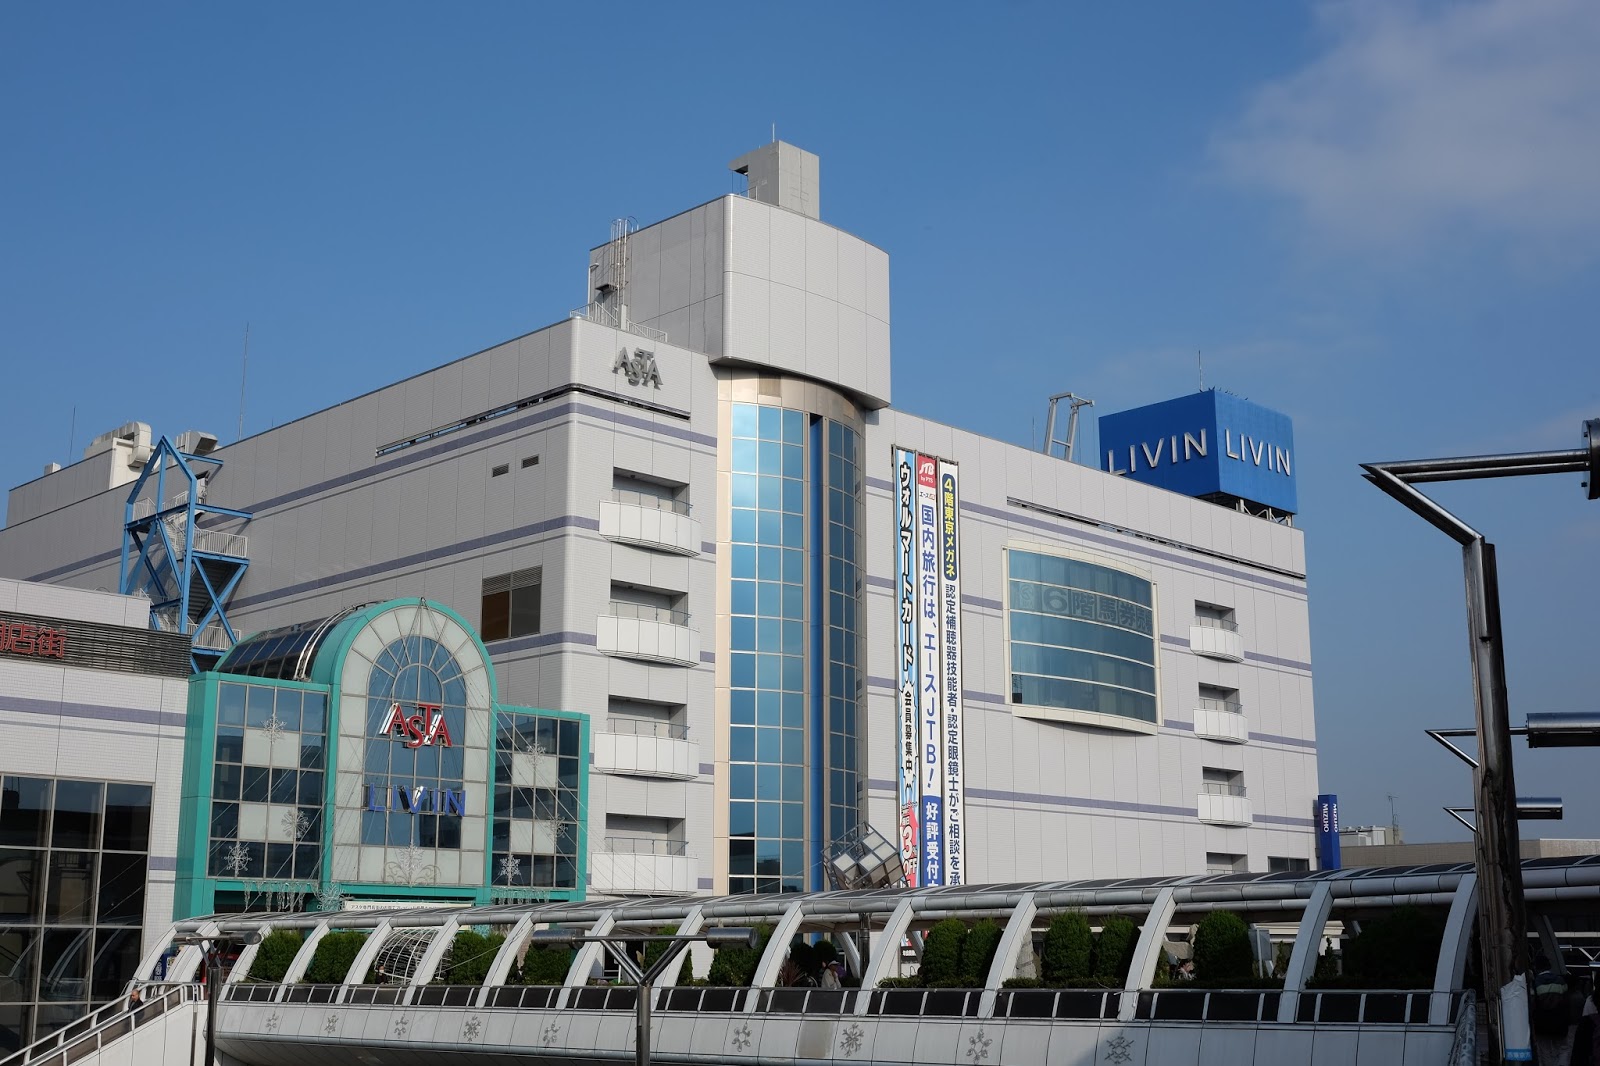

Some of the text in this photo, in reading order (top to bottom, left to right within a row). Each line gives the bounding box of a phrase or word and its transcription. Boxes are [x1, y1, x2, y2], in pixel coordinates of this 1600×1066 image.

[612, 346, 664, 390] ASTA
[919, 462, 935, 476] JTB
[1107, 428, 1208, 476] LIVIN
[1225, 427, 1292, 477] LIVIN
[899, 461, 914, 672] ウォルマートカード
[0, 621, 67, 659] 店街
[379, 702, 453, 748] ASTA
[366, 783, 466, 817] LIVIN
